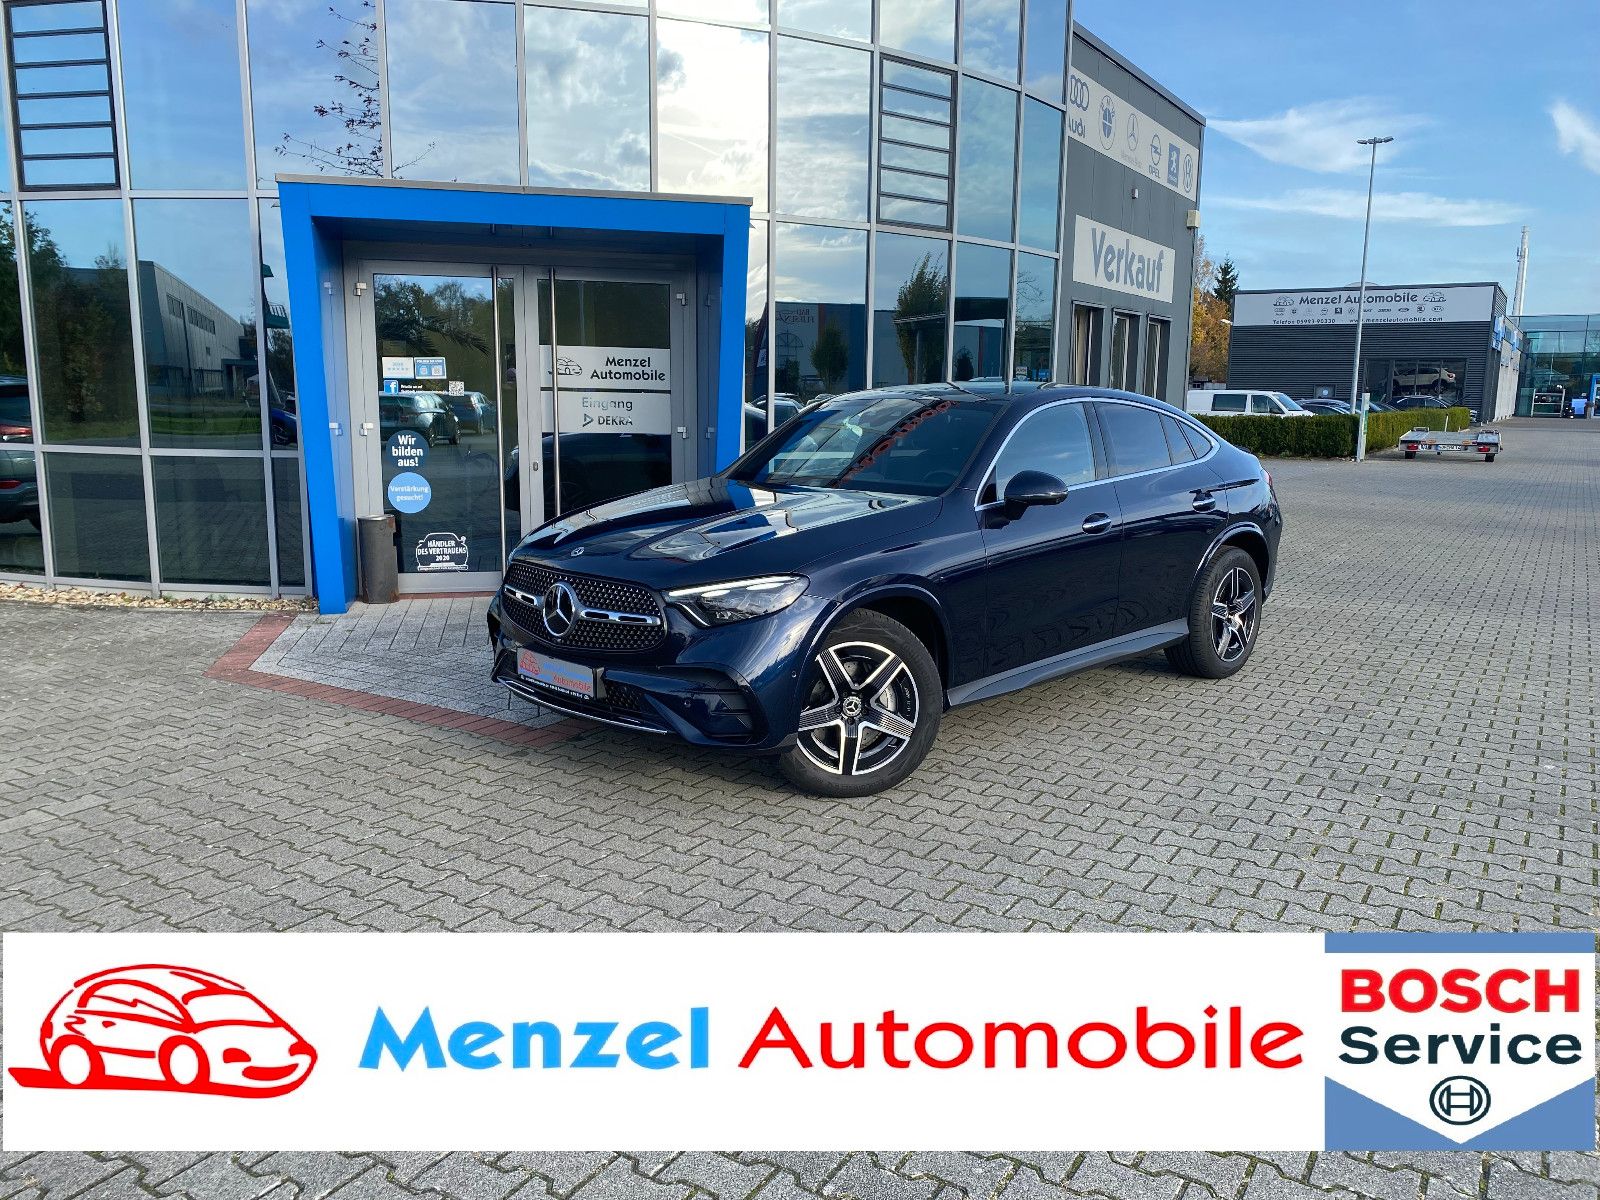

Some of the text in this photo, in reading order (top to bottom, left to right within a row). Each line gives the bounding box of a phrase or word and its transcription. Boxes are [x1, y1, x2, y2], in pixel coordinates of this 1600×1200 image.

[1091, 227, 1164, 294] Verkauf
[1299, 294, 1342, 305] Menzel
[605, 356, 651, 368] Menzel
[590, 369, 666, 381] Automobile
[582, 397, 633, 411] Eingang
[597, 415, 633, 426] DEKRA
[397, 434, 417, 446] Wir
[391, 446, 424, 457] bilden
[397, 457, 419, 467] aus!
[427, 540, 456, 548] HÄNDLER
[428, 547, 467, 555] VERTRAUENS
